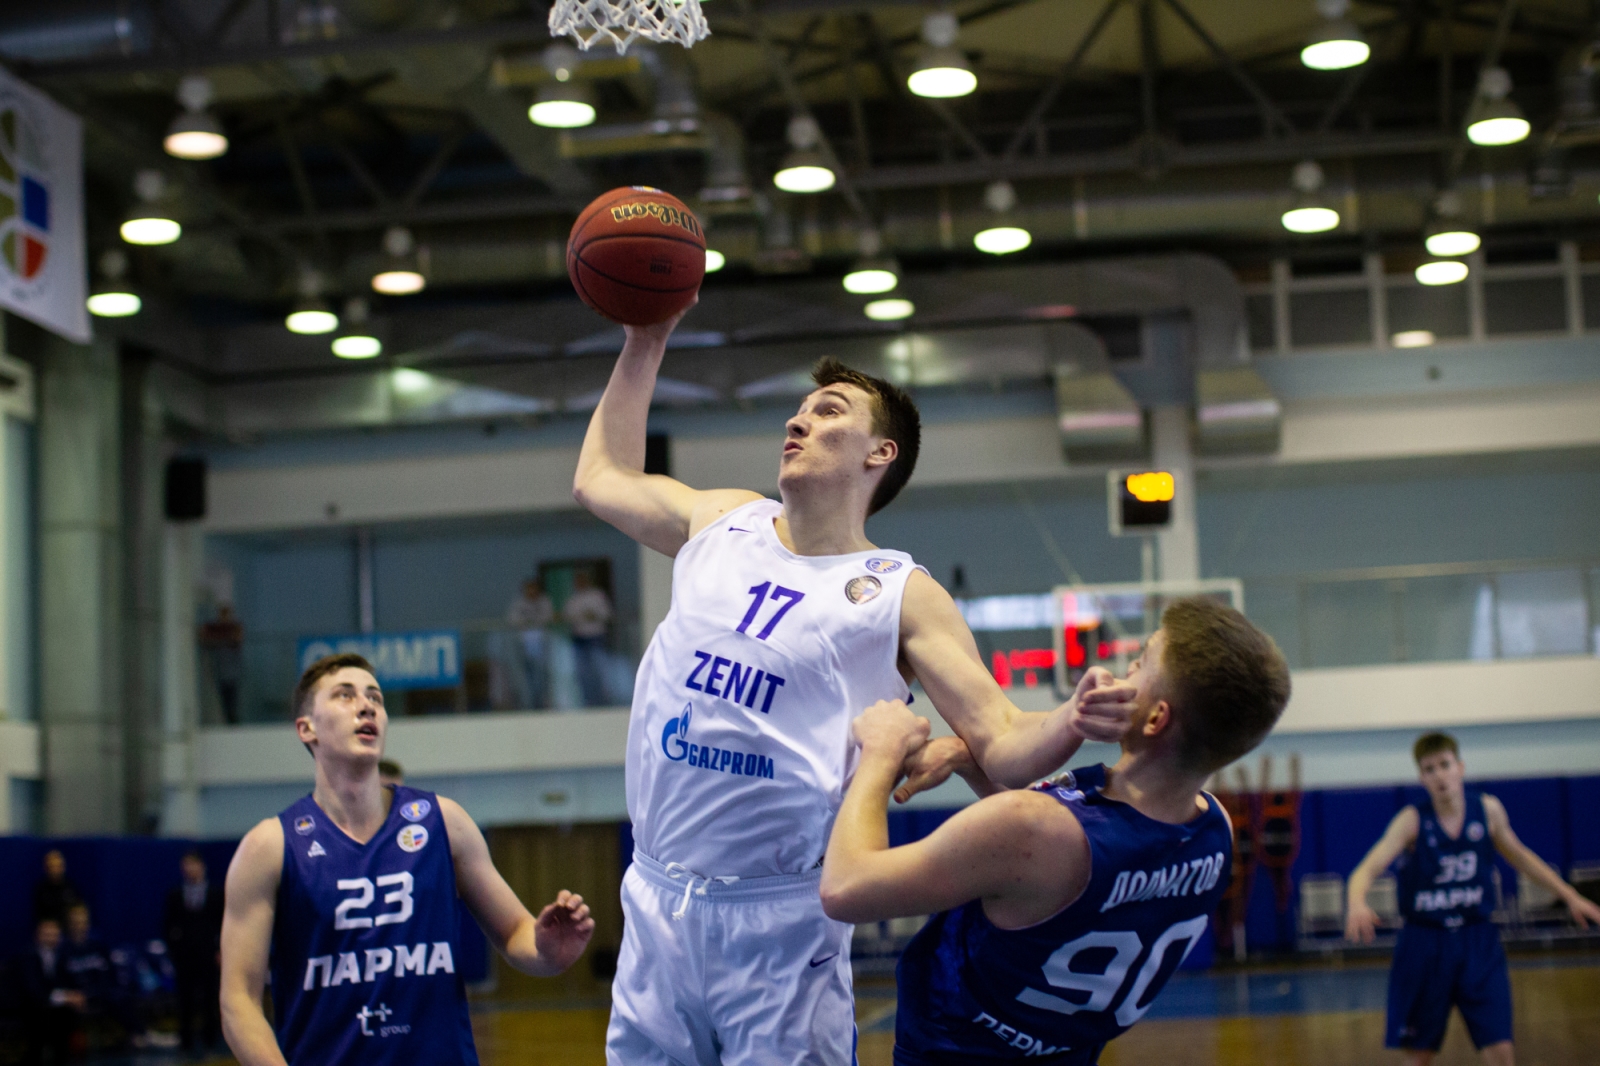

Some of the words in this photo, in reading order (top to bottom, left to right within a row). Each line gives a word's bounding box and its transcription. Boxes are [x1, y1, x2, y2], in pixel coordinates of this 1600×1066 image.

[611, 205, 699, 237] Wilson
[736, 581, 805, 640] 17
[686, 650, 785, 714] ZENIT
[688, 744, 774, 779] GAZPROM
[1435, 851, 1478, 884] 39
[334, 871, 414, 930] 23
[303, 942, 455, 991] ПАРМА
[1015, 913, 1208, 1028] 90
[972, 1012, 1072, 1057] ПЕРМ
